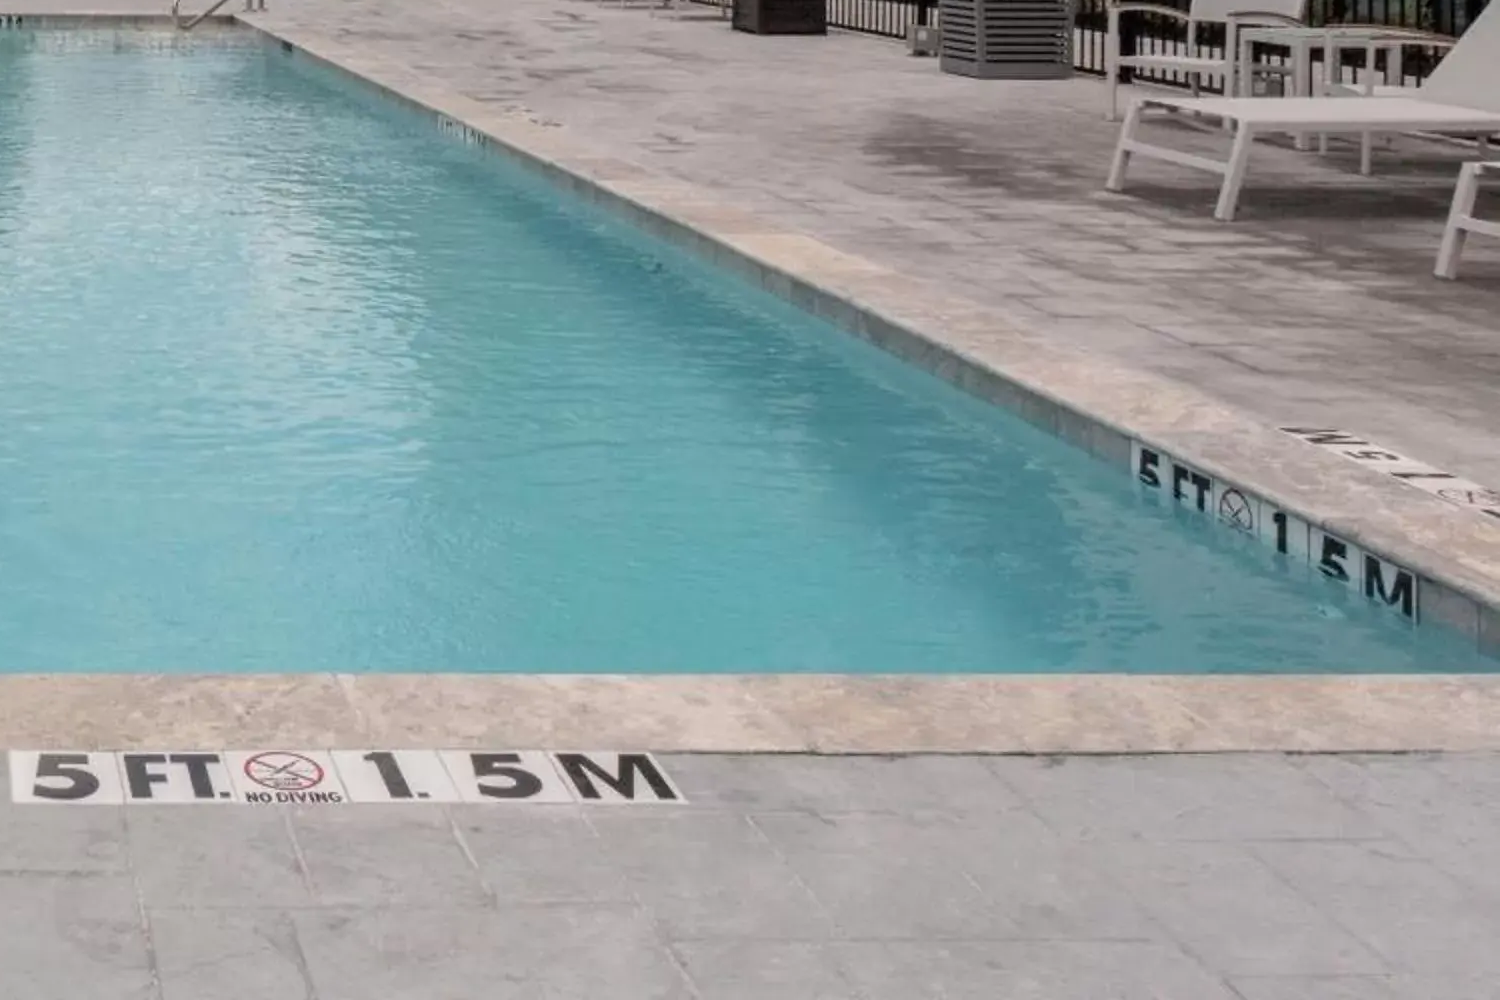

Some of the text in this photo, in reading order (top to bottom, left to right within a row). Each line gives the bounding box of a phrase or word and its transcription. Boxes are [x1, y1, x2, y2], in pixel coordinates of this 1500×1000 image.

[1138, 448, 1414, 618] 5 FT 1 5 M
[33, 754, 100, 800] 5
[123, 754, 231, 799] FT.
[470, 753, 543, 799] 5
[554, 753, 678, 800] M
[245, 791, 343, 803] NO DIVING
